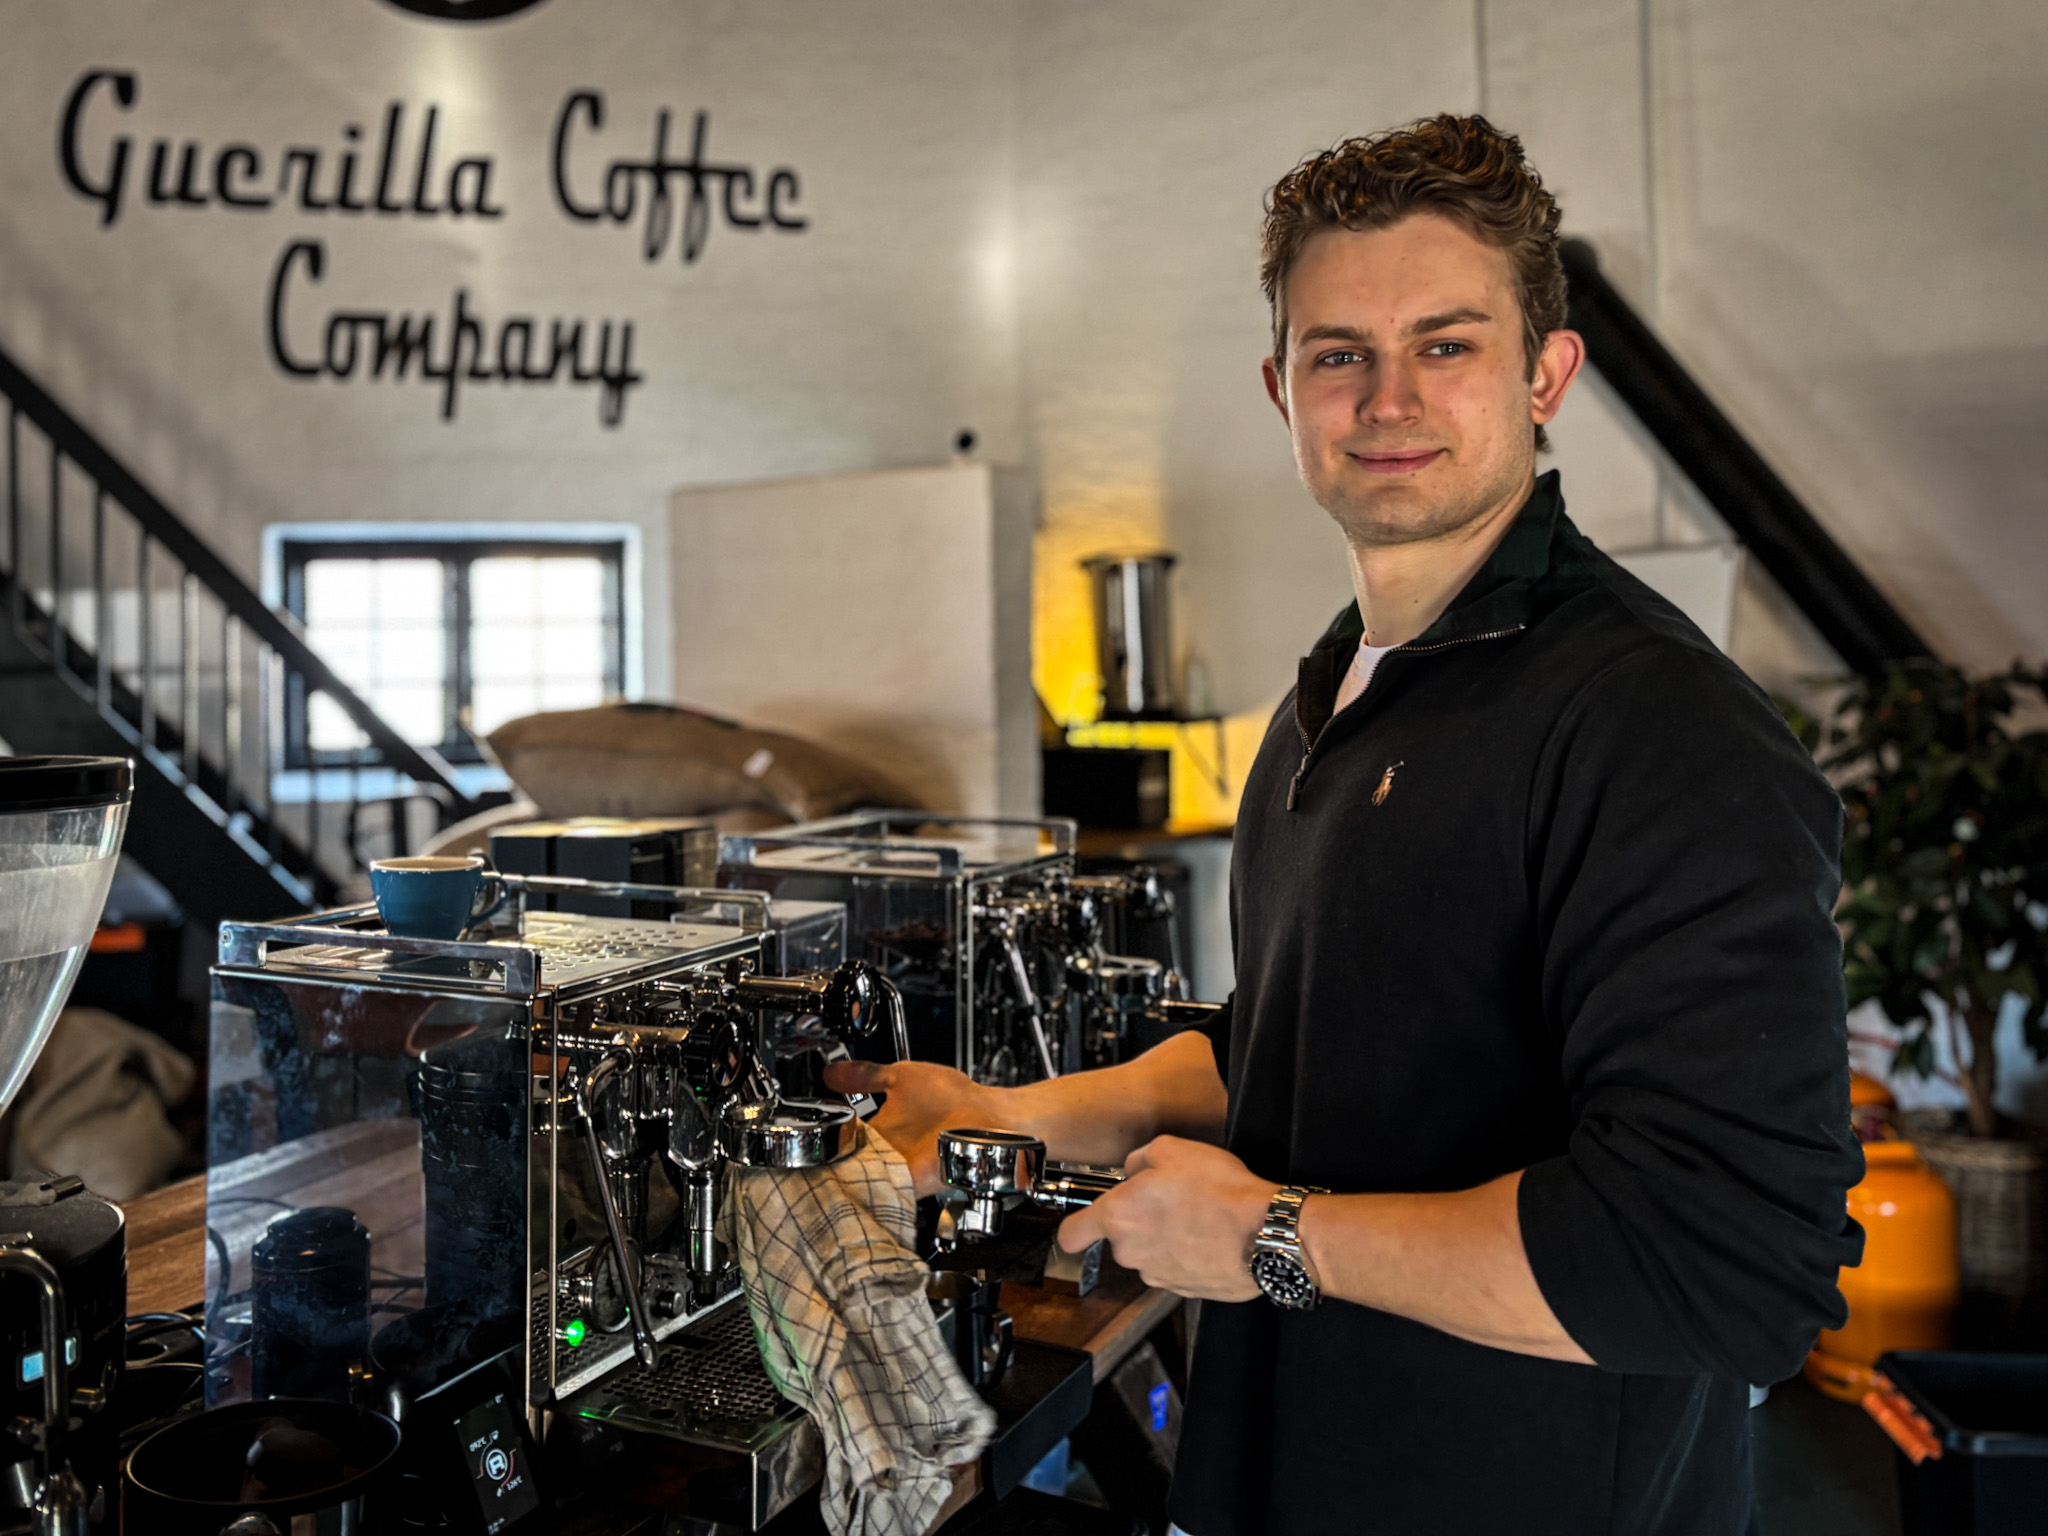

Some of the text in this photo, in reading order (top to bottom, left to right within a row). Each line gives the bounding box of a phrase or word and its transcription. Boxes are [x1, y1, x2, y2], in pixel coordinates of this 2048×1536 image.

[57, 68, 809, 263] Guerilla Coffee
[267, 237, 646, 429] Company
